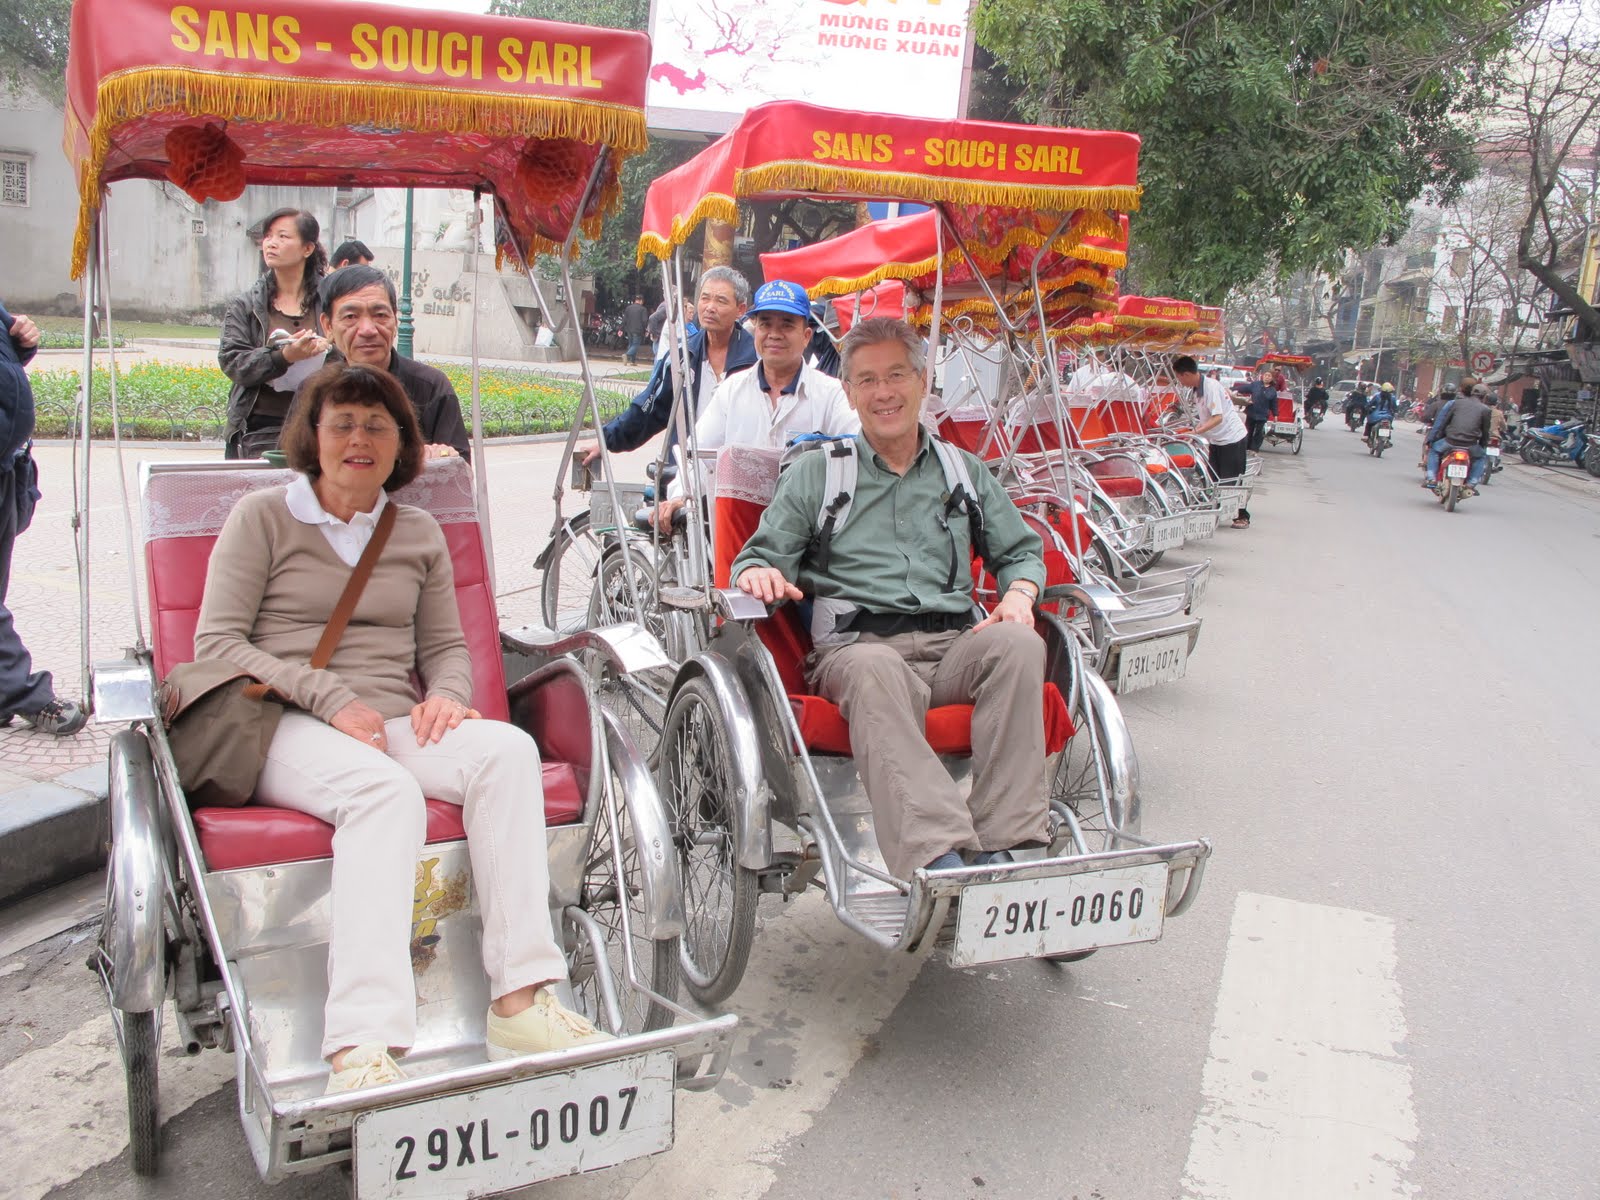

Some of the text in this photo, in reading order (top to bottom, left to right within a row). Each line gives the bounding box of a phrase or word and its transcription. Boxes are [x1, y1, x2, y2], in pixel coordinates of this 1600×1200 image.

[170, 5, 301, 65] SANS
[350, 23, 483, 80] SOUCI
[496, 37, 602, 89] SARL
[895, 39, 960, 57] XUÂN
[812, 130, 893, 163] SANS
[924, 138, 1006, 171] SOUCI
[1014, 143, 1083, 175] SARL
[1127, 647, 1180, 678] 29XL-0074
[983, 887, 1144, 939] 29XL-0060
[394, 1086, 638, 1181] 29XL-0007
